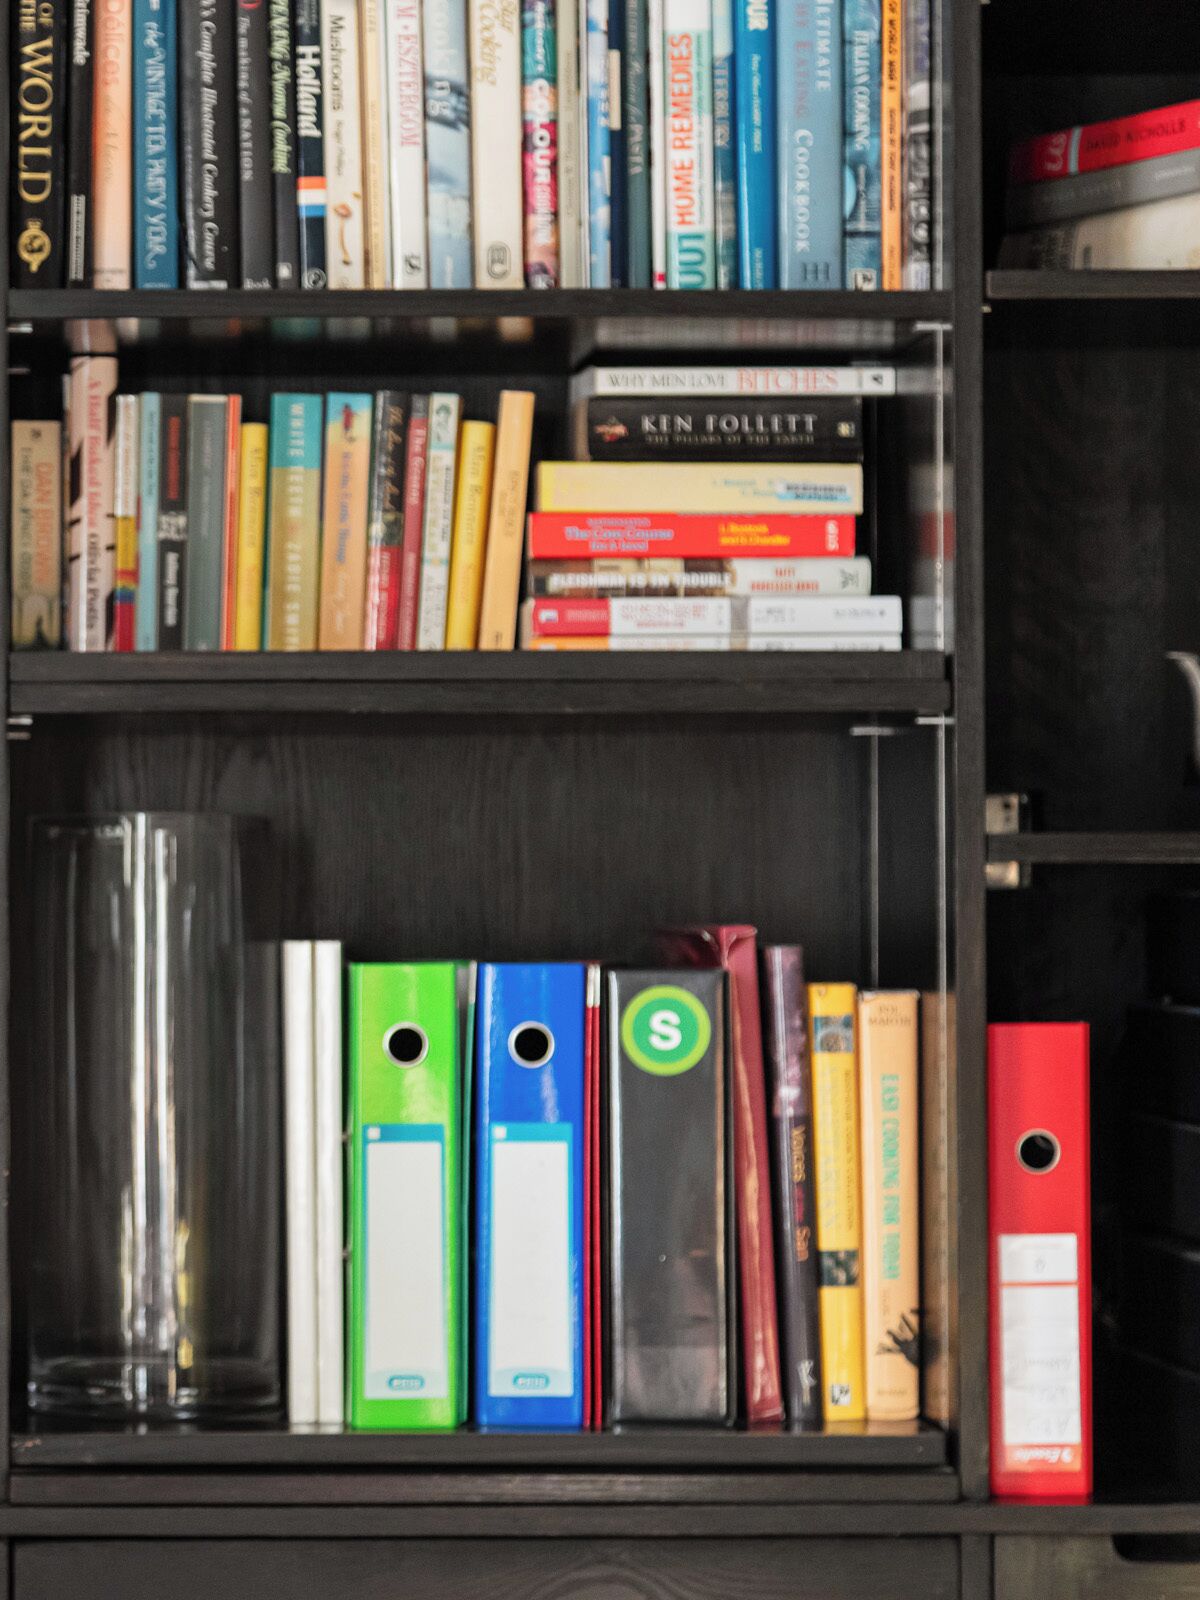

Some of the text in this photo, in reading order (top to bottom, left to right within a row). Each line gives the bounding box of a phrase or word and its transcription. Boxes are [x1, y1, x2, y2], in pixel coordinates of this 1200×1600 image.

[20, 0, 37, 33] THE
[38, 3, 55, 28] OF
[477, 3, 502, 86] Cooking
[237, 37, 252, 89] making
[296, 45, 323, 138] Holland
[329, 15, 346, 112] Mushrooms
[398, 34, 421, 147] ESZTERGOM
[668, 33, 693, 150] REMEDIES
[853, 30, 871, 151] ITALIAN COOKING
[18, 36, 54, 204] WORLD
[239, 91, 253, 105] of
[271, 61, 292, 174] Nyonya Cooking
[144, 21, 167, 270] the VINTAGE TEA PARTY YEAR
[195, 21, 220, 271] Complete Illustrated Cookery Course
[240, 118, 254, 182] NATION
[532, 78, 551, 183] COLOUR
[628, 123, 645, 176] PASTA
[1125, 118, 1187, 145] NICHOLLS
[793, 129, 814, 253] COOKBOOK
[89, 378, 101, 390] A
[608, 369, 839, 393] WHY MEN LOVE BITCHES
[88, 394, 102, 431] Half
[411, 428, 425, 452] The
[641, 413, 818, 434] KEN FOLLETT
[646, 434, 815, 446] THE PILLARS OF THE EARTH
[88, 435, 102, 488] Baked
[35, 462, 53, 584] DAN BROWN
[286, 402, 305, 592] WHITE TEETH ZADIE
[674, 571, 732, 589] TROUBLE
[648, 1010, 683, 1052] S
[790, 1125, 807, 1183] Voices
[880, 1073, 901, 1280] EASY COOKING FOR TODAY
